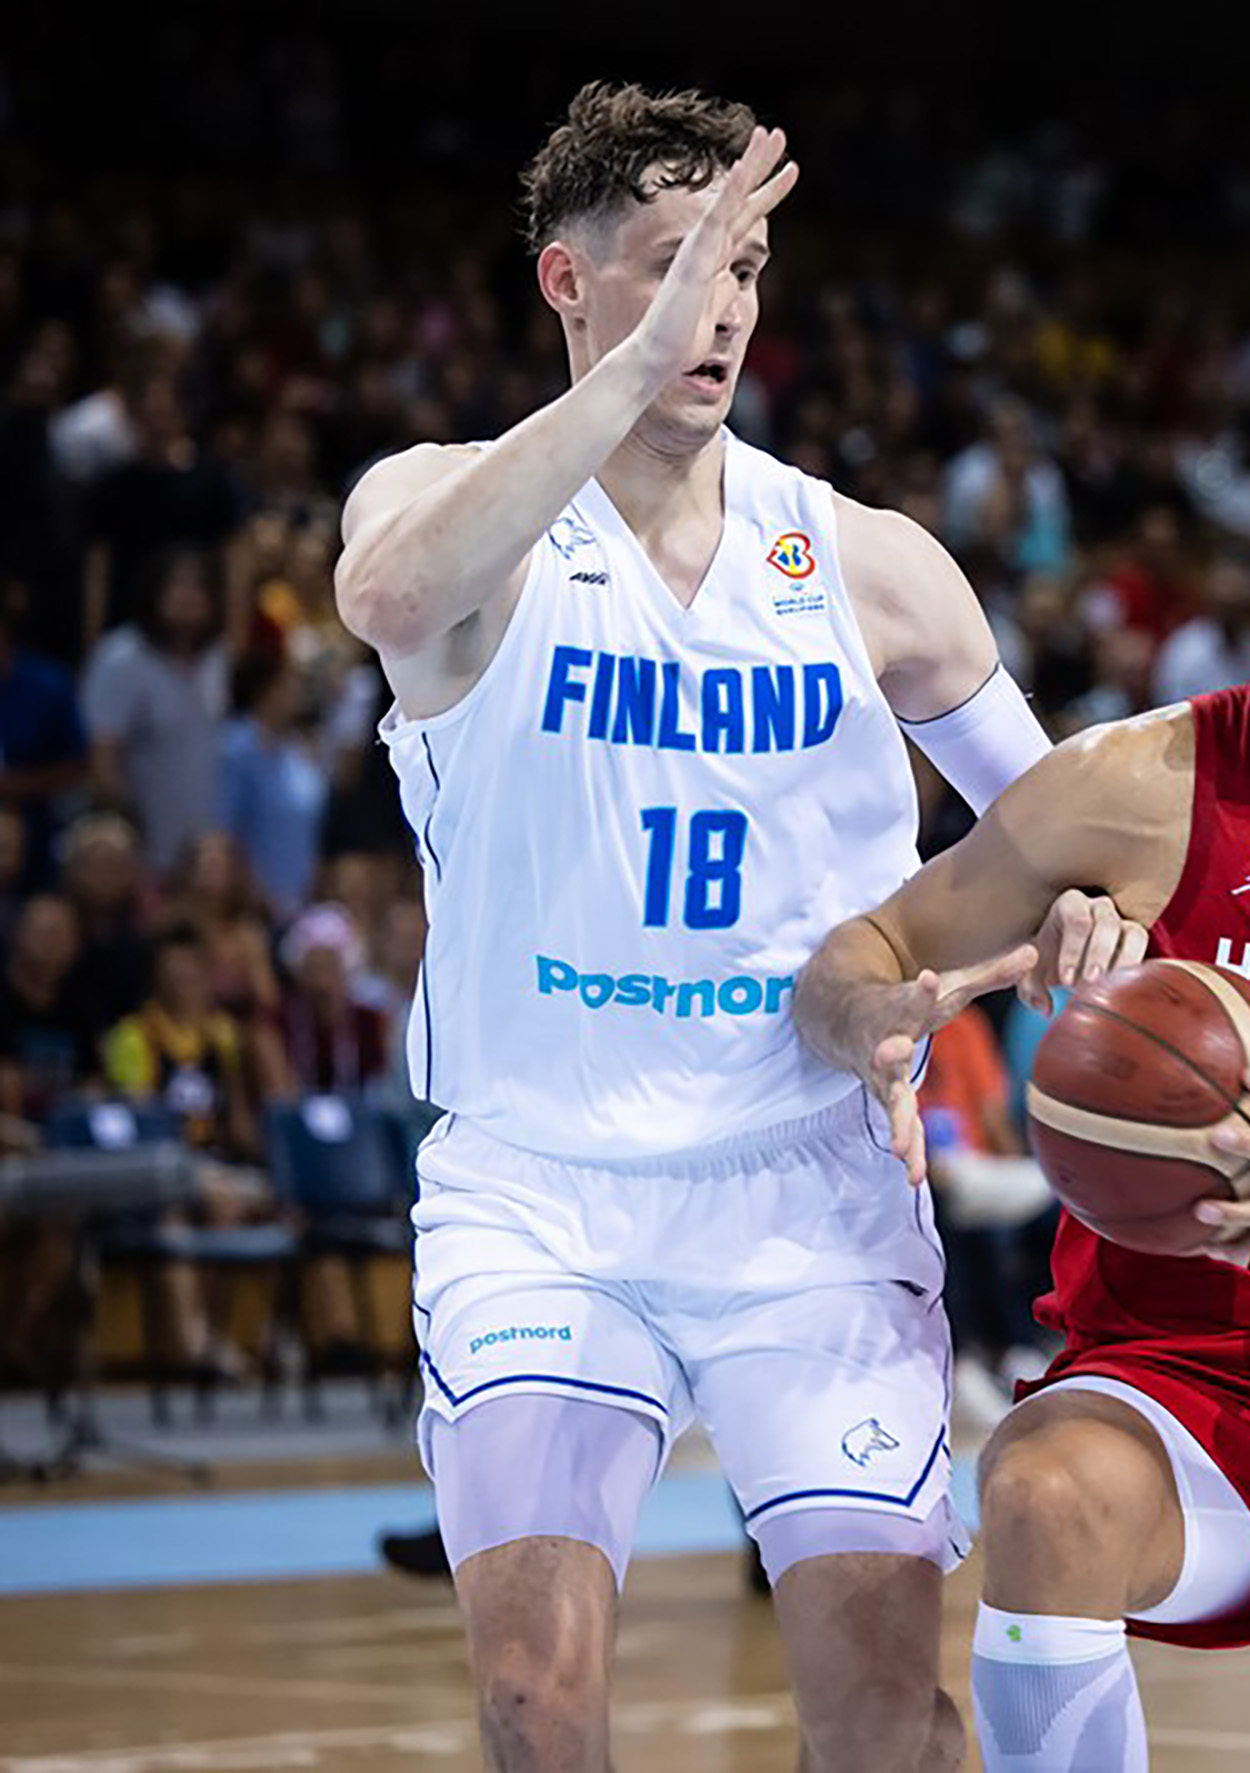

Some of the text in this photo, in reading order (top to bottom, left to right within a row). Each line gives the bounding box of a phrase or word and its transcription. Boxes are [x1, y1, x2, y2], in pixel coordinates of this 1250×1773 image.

[541, 645, 844, 755] FINLAND
[639, 806, 749, 931] 18
[535, 954, 795, 1018] postnor
[469, 1325, 572, 1355] postnord
